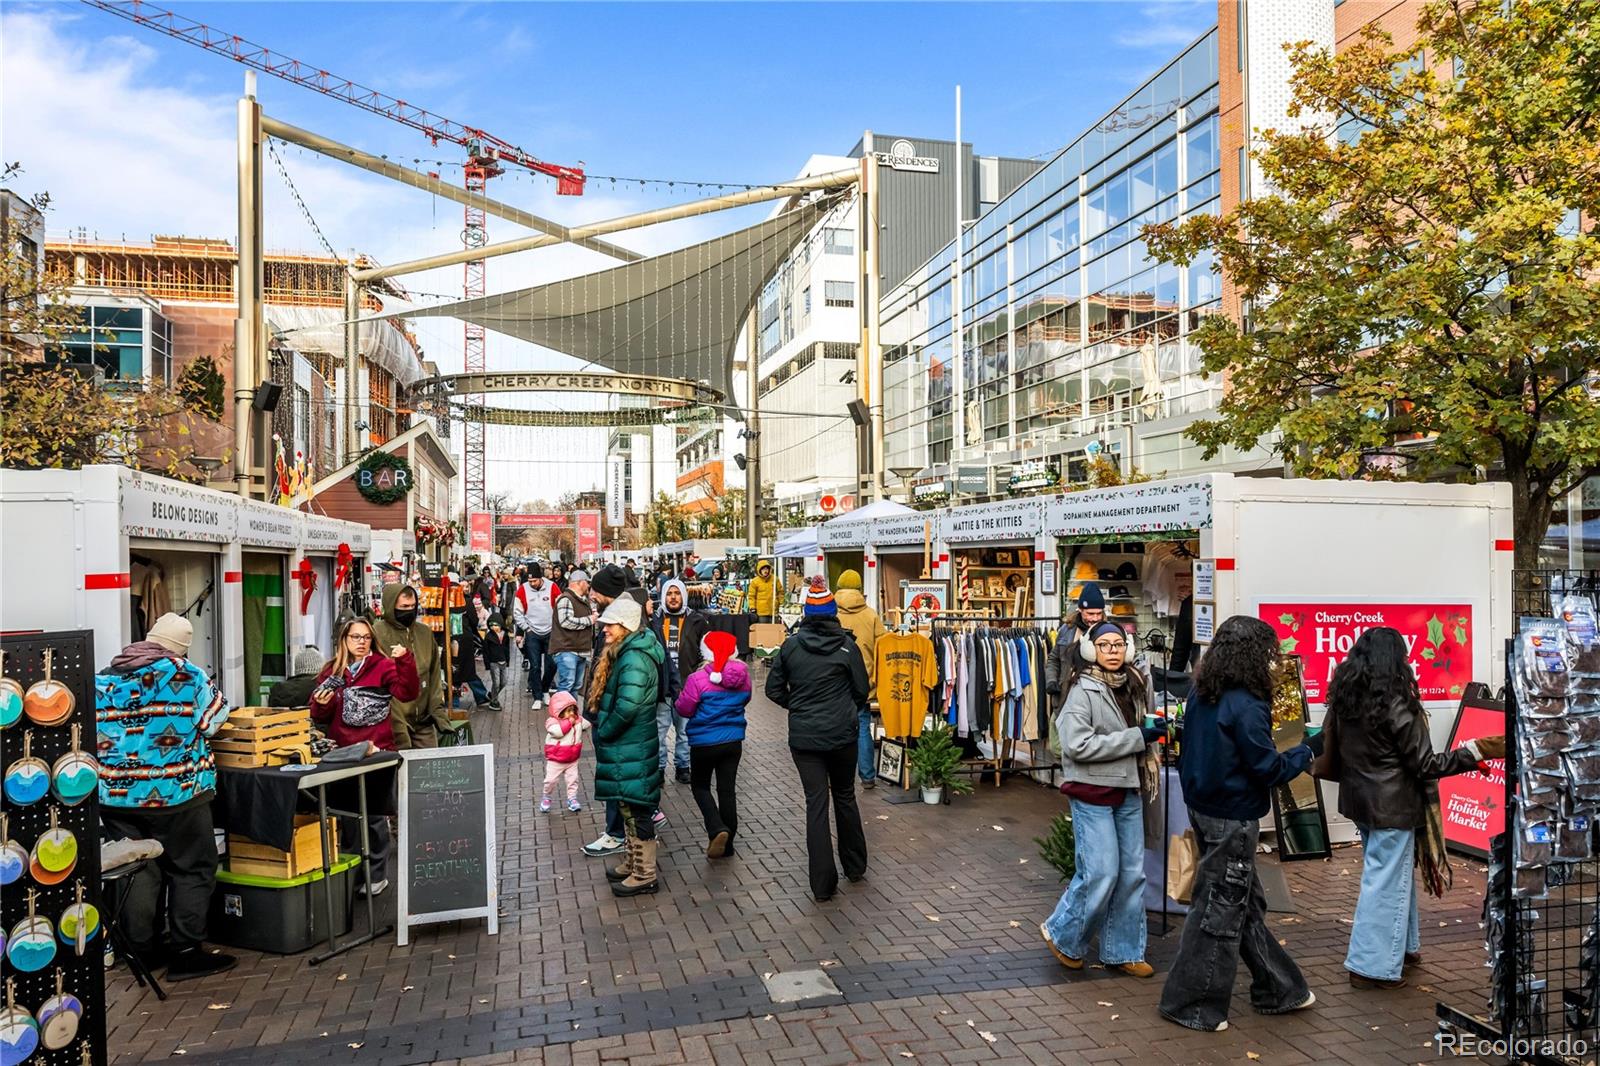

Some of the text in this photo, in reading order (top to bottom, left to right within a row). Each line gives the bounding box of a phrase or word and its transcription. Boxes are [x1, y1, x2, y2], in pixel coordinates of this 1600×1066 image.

[888, 154, 938, 168] RESDENCES
[482, 375, 672, 393] CHERRY CREEK NORTH
[360, 470, 407, 487] BAR
[151, 502, 219, 526] BELONG DESIGNS
[1063, 510, 1092, 521] DOPAMINE
[1092, 507, 1134, 518] MANAGEMENT
[1135, 503, 1180, 515] DEPARTMENT
[885, 527, 908, 536] WANDERING
[909, 525, 924, 534] WAGON
[953, 516, 1022, 531] MATTIE & THE KITTIES
[1315, 611, 1385, 625] Cherry Creek
[1315, 625, 1418, 657] Holy
[1429, 687, 1446, 695] 12/24
[1485, 760, 1506, 771] ONL
[1479, 772, 1506, 785] POIN
[1450, 793, 1480, 805] Cherry Creek
[1447, 799, 1491, 820] Holiday
[1447, 810, 1488, 831] Market
